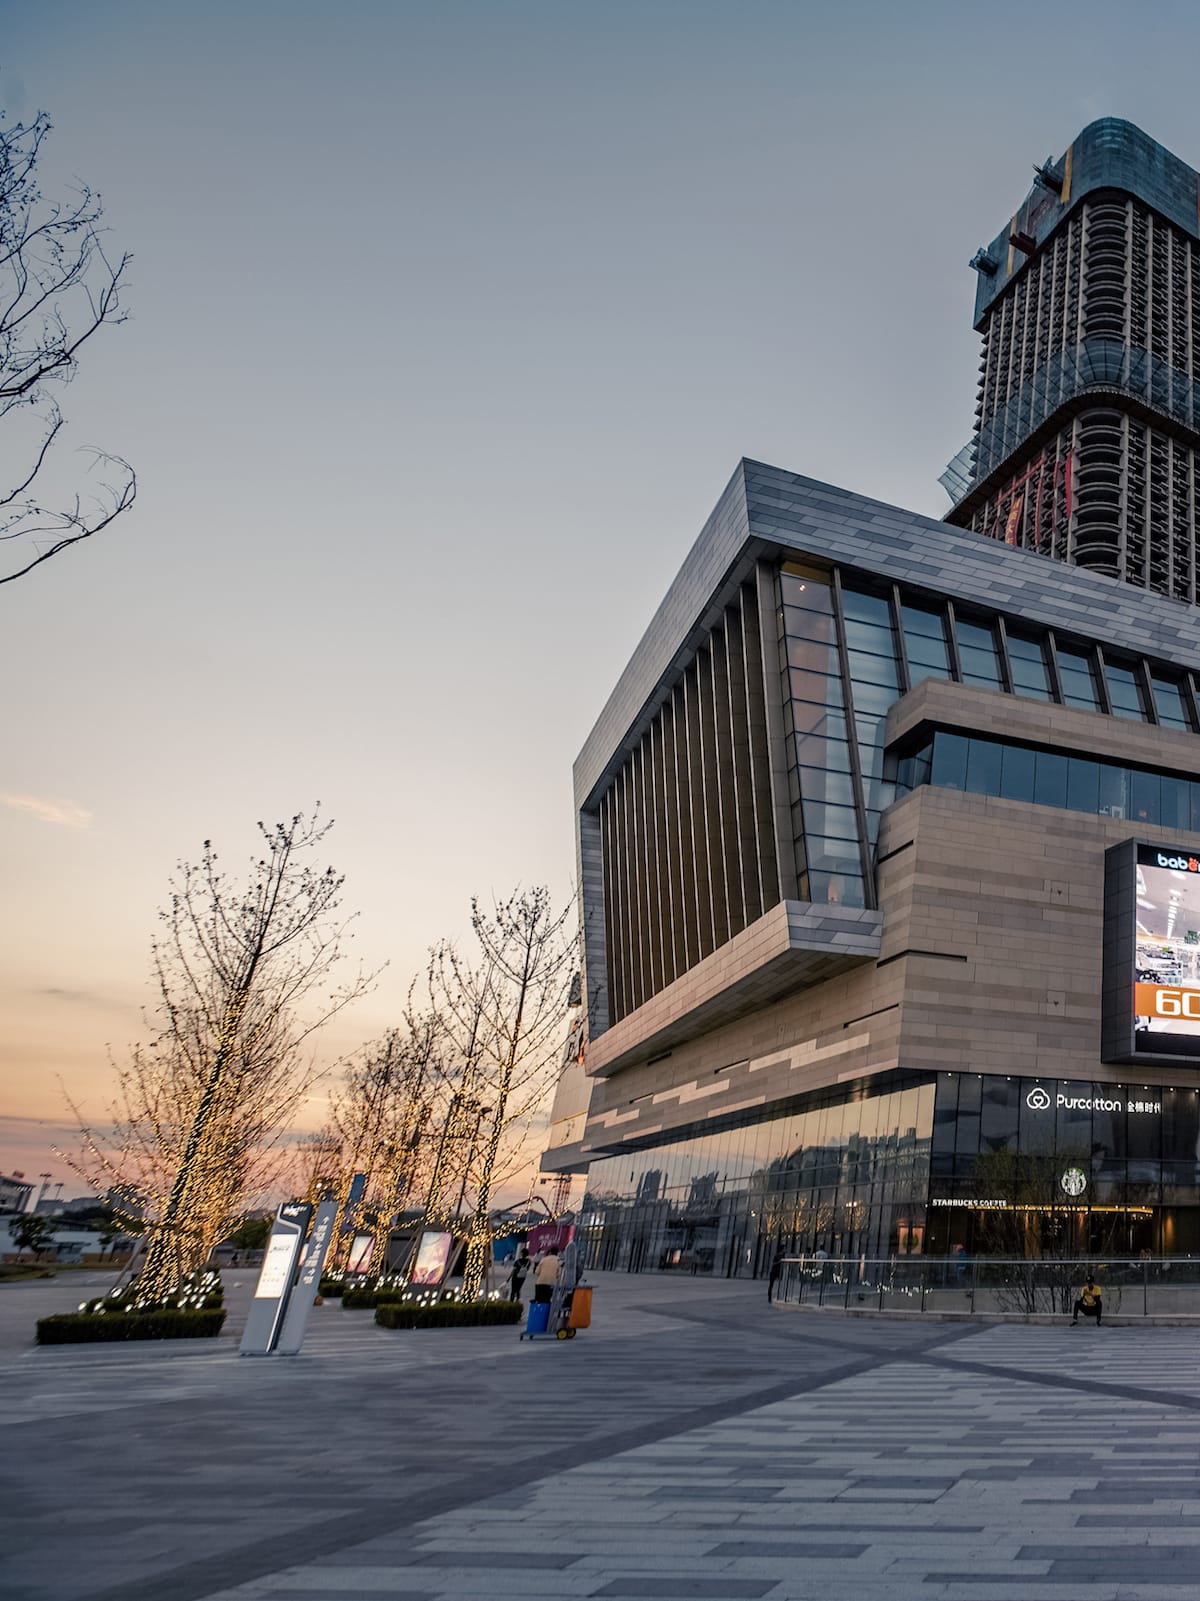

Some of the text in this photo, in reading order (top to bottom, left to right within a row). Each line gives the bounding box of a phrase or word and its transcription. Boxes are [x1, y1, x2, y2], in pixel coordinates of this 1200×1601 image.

[1056, 1094, 1160, 1114] Purcotton 全棉时代
[932, 1199, 978, 1207] STARBUCKS
